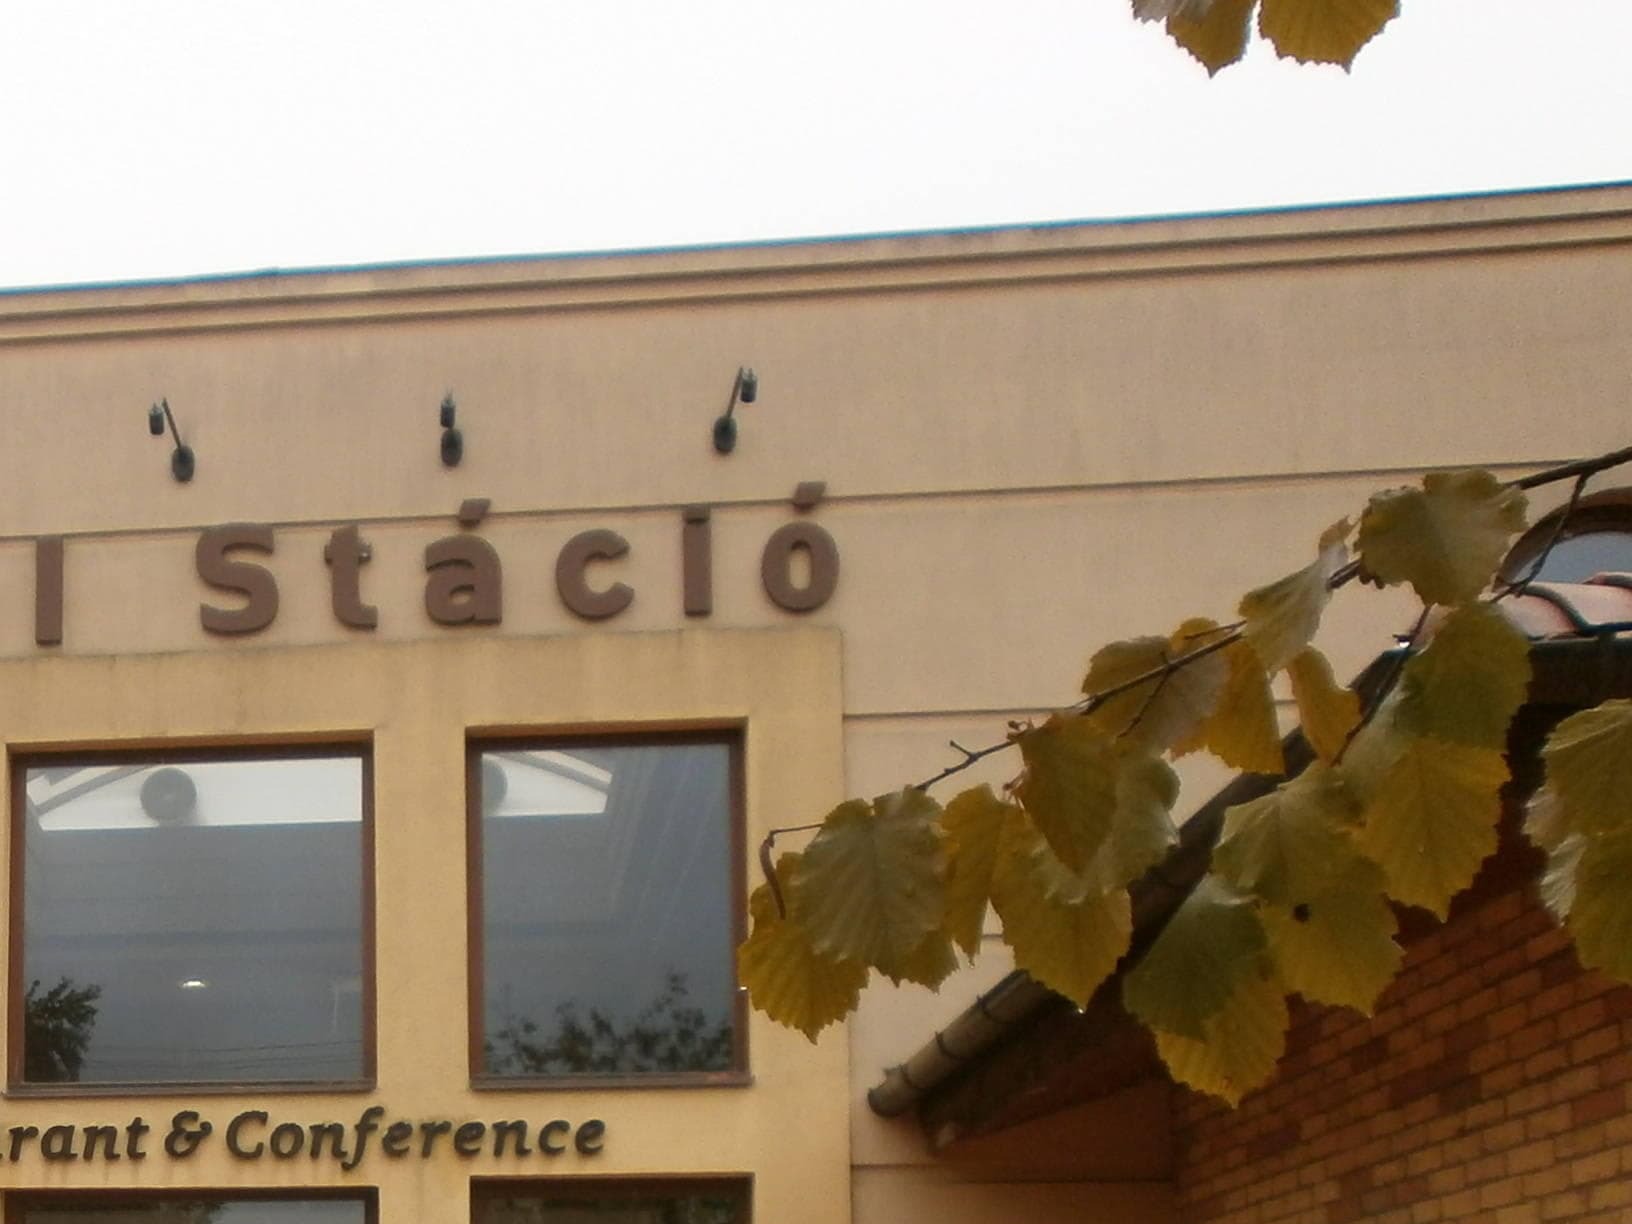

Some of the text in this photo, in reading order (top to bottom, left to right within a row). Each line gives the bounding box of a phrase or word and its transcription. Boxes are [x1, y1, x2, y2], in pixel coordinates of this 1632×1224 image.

[195, 480, 840, 637] Stáció
[165, 1110, 212, 1159] &
[226, 1105, 606, 1171] Conference
